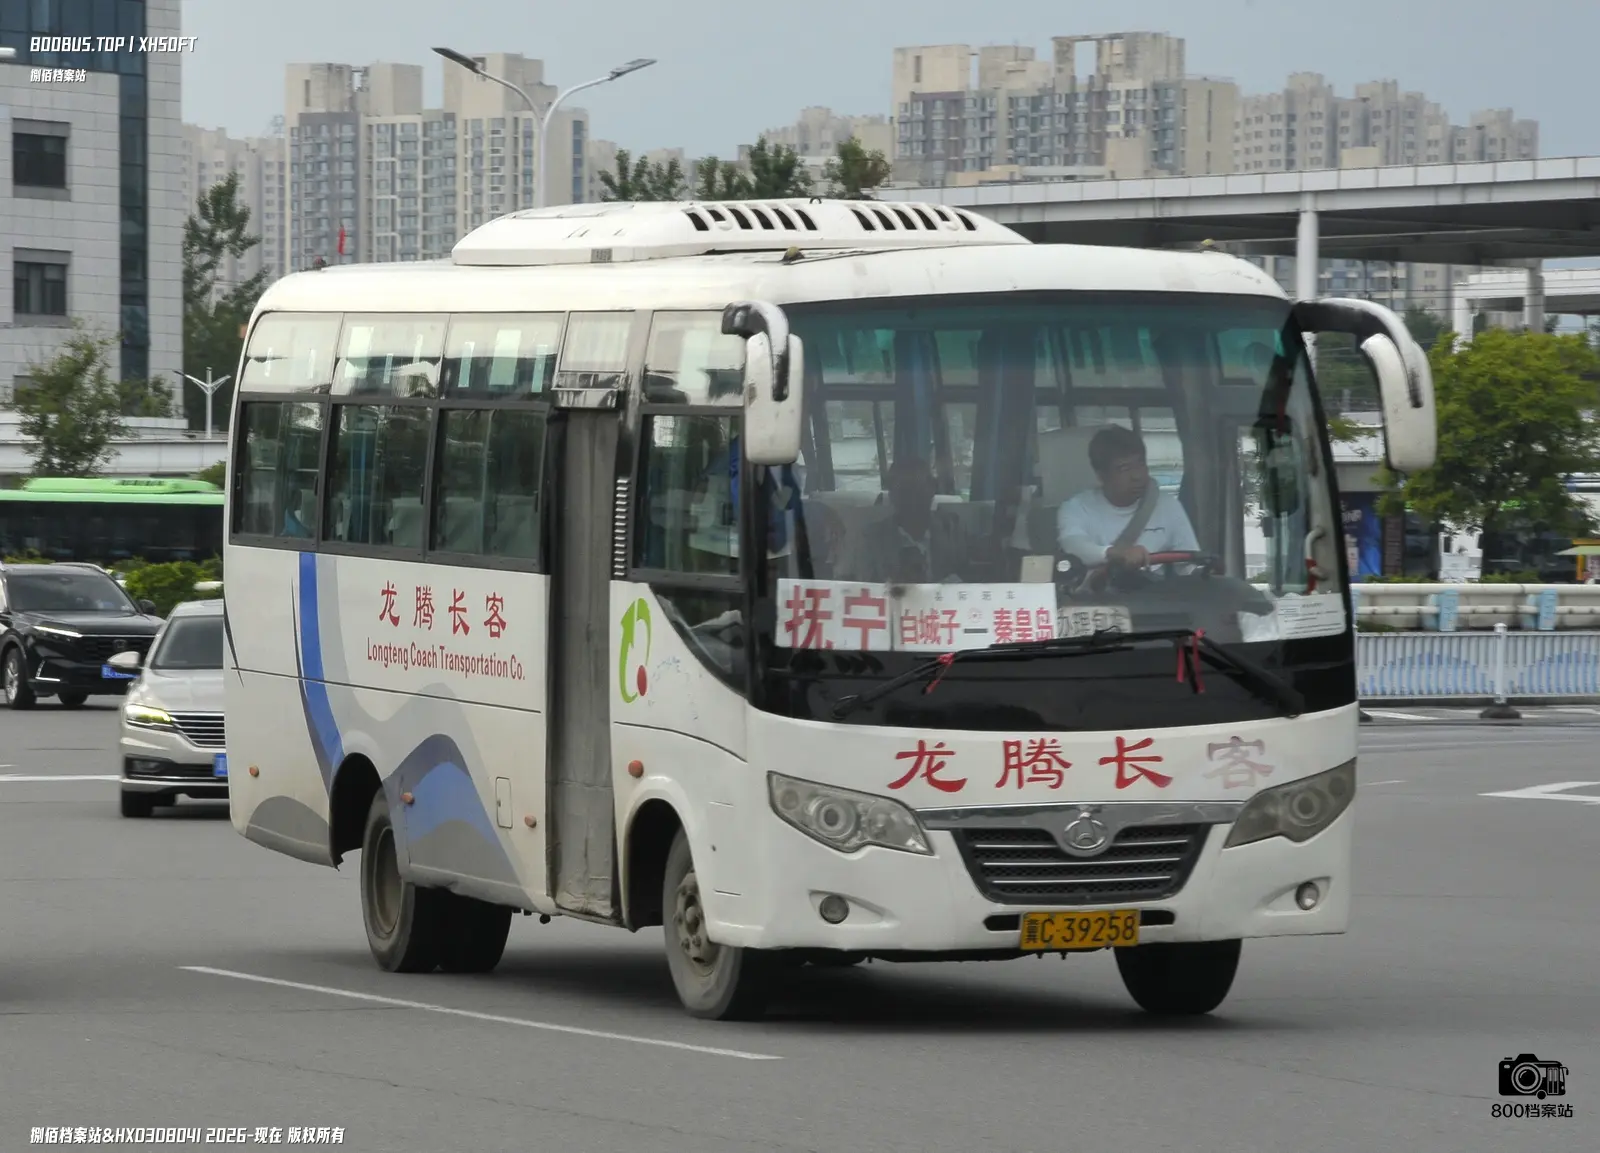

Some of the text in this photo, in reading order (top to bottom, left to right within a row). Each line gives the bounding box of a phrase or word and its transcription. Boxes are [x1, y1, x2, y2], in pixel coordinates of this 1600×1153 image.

[379, 580, 507, 638] 龙腾长客
[784, 584, 887, 651] 抚宁
[367, 637, 526, 681] Longteng Coach Transportation Co.
[887, 735, 1276, 793] 龙腾长客
